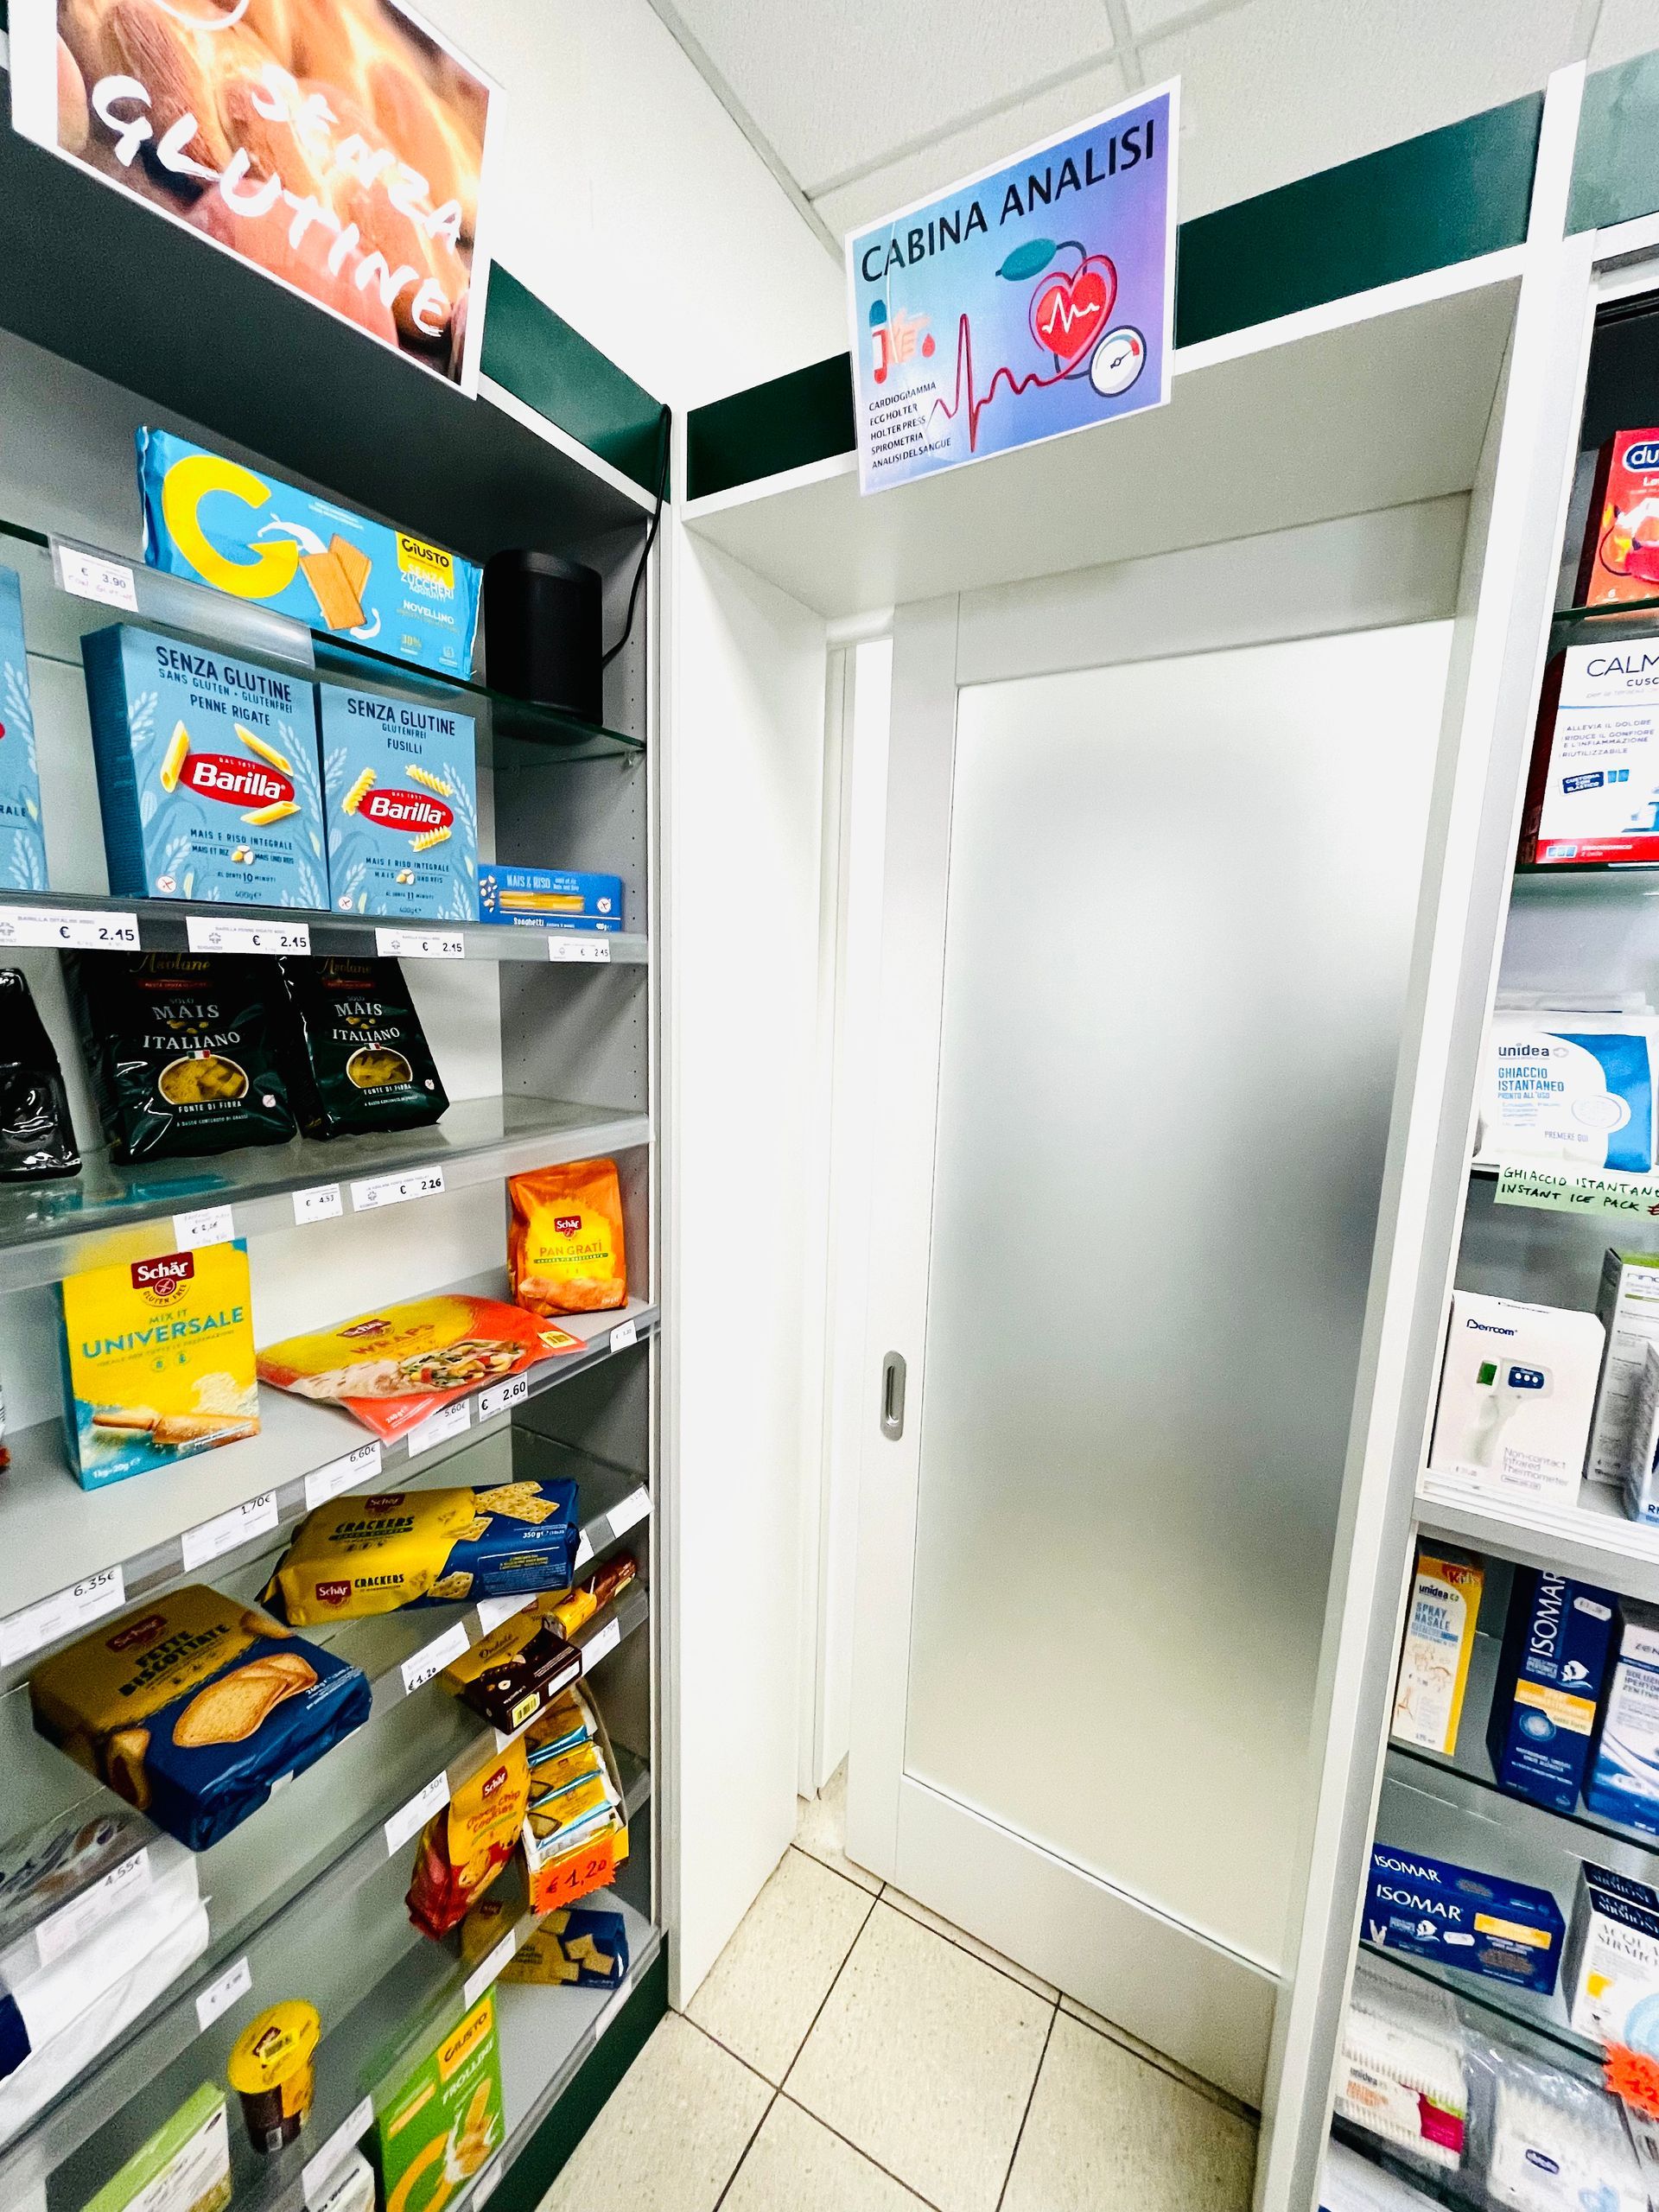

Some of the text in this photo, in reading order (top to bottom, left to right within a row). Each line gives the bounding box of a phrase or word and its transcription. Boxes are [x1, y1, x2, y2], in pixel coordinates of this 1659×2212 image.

[251, 63, 462, 254] SENZA
[92, 75, 443, 337] GLUTINE
[861, 119, 1155, 283] CABINA ANALISI
[869, 381, 937, 411] CARDIOGRAMMA
[870, 403, 918, 426] ECG HOLTER
[870, 415, 925, 441] HOLTER PRESS
[871, 432, 923, 455] SPIROMETRIA
[872, 437, 951, 468] ANALISI DEL SANGUE
[102, 574, 126, 588] 3.90
[403, 600, 454, 624] NOVELLINO
[156, 646, 292, 702] SENZA GLUTINE
[158, 668, 293, 714] SANS GLUTEN GLUTENFREI
[190, 694, 270, 726] PENNE RIGATE
[347, 697, 455, 735] SENZA GLUTINE
[382, 723, 427, 739] GLUTENFREI
[387, 738, 423, 754] FUSILLI
[1562, 748, 1628, 757] RIUTILIZZABILE
[192, 762, 282, 799] Barilla
[370, 796, 443, 824] Barilla
[190, 830, 213, 840] MAIS
[226, 834, 246, 844] RISO
[251, 836, 292, 850] INTEGRALE
[415, 862, 449, 872] INTEGRALE
[243, 873, 253, 882] 10
[60, 926, 71, 938] €
[513, 917, 544, 927] Spaghetti
[252, 935, 260, 945] €
[423, 942, 429, 951] €
[152, 1004, 219, 1020] MAIS
[334, 1003, 383, 1017] MAIS
[143, 1032, 241, 1050] ITALIANO
[333, 1027, 400, 1041] ITALIANO
[1498, 1043, 1549, 1056] unidea
[1498, 1067, 1548, 1078] GHIACCIO
[1498, 1080, 1564, 1091] ISTANTANEO
[178, 1104, 204, 1113] FONTE
[1545, 1131, 1574, 1141] PREMERE
[400, 1185, 406, 1194] €
[422, 1178, 442, 1190] 2.26
[1503, 1166, 1567, 1186] GHIACCIO
[1501, 1184, 1640, 1211] INSTANT ICE PACK
[556, 1219, 580, 1230] Schär
[539, 1246, 563, 1257] PAN
[137, 1262, 188, 1281] Schär
[143, 1284, 187, 1305] GLUTEN FREE
[82, 1306, 245, 1359] UNIVERSALE
[481, 1381, 525, 1410] € 2.60
[1503, 1456, 1541, 1471] Infrared
[1504, 1446, 1567, 1469] Non-contact
[1504, 1463, 1569, 1487] Thermometer
[335, 1516, 415, 1533] CRACKERS
[73, 1571, 115, 1597] 6.35€
[354, 1574, 404, 1587] CRACKERS
[319, 1586, 347, 1596] Schär
[1419, 1584, 1448, 1599] unidea
[1416, 1601, 1447, 1618] SPRAY
[1414, 1611, 1450, 1631] NASALE
[136, 1630, 193, 1668] FETTE
[118, 1624, 230, 1697] BISCOTTATE
[545, 1859, 607, 1893] € 1,20
[1374, 1853, 1441, 1884] ISOMAR
[1376, 1884, 1462, 1922] ISOMAR
